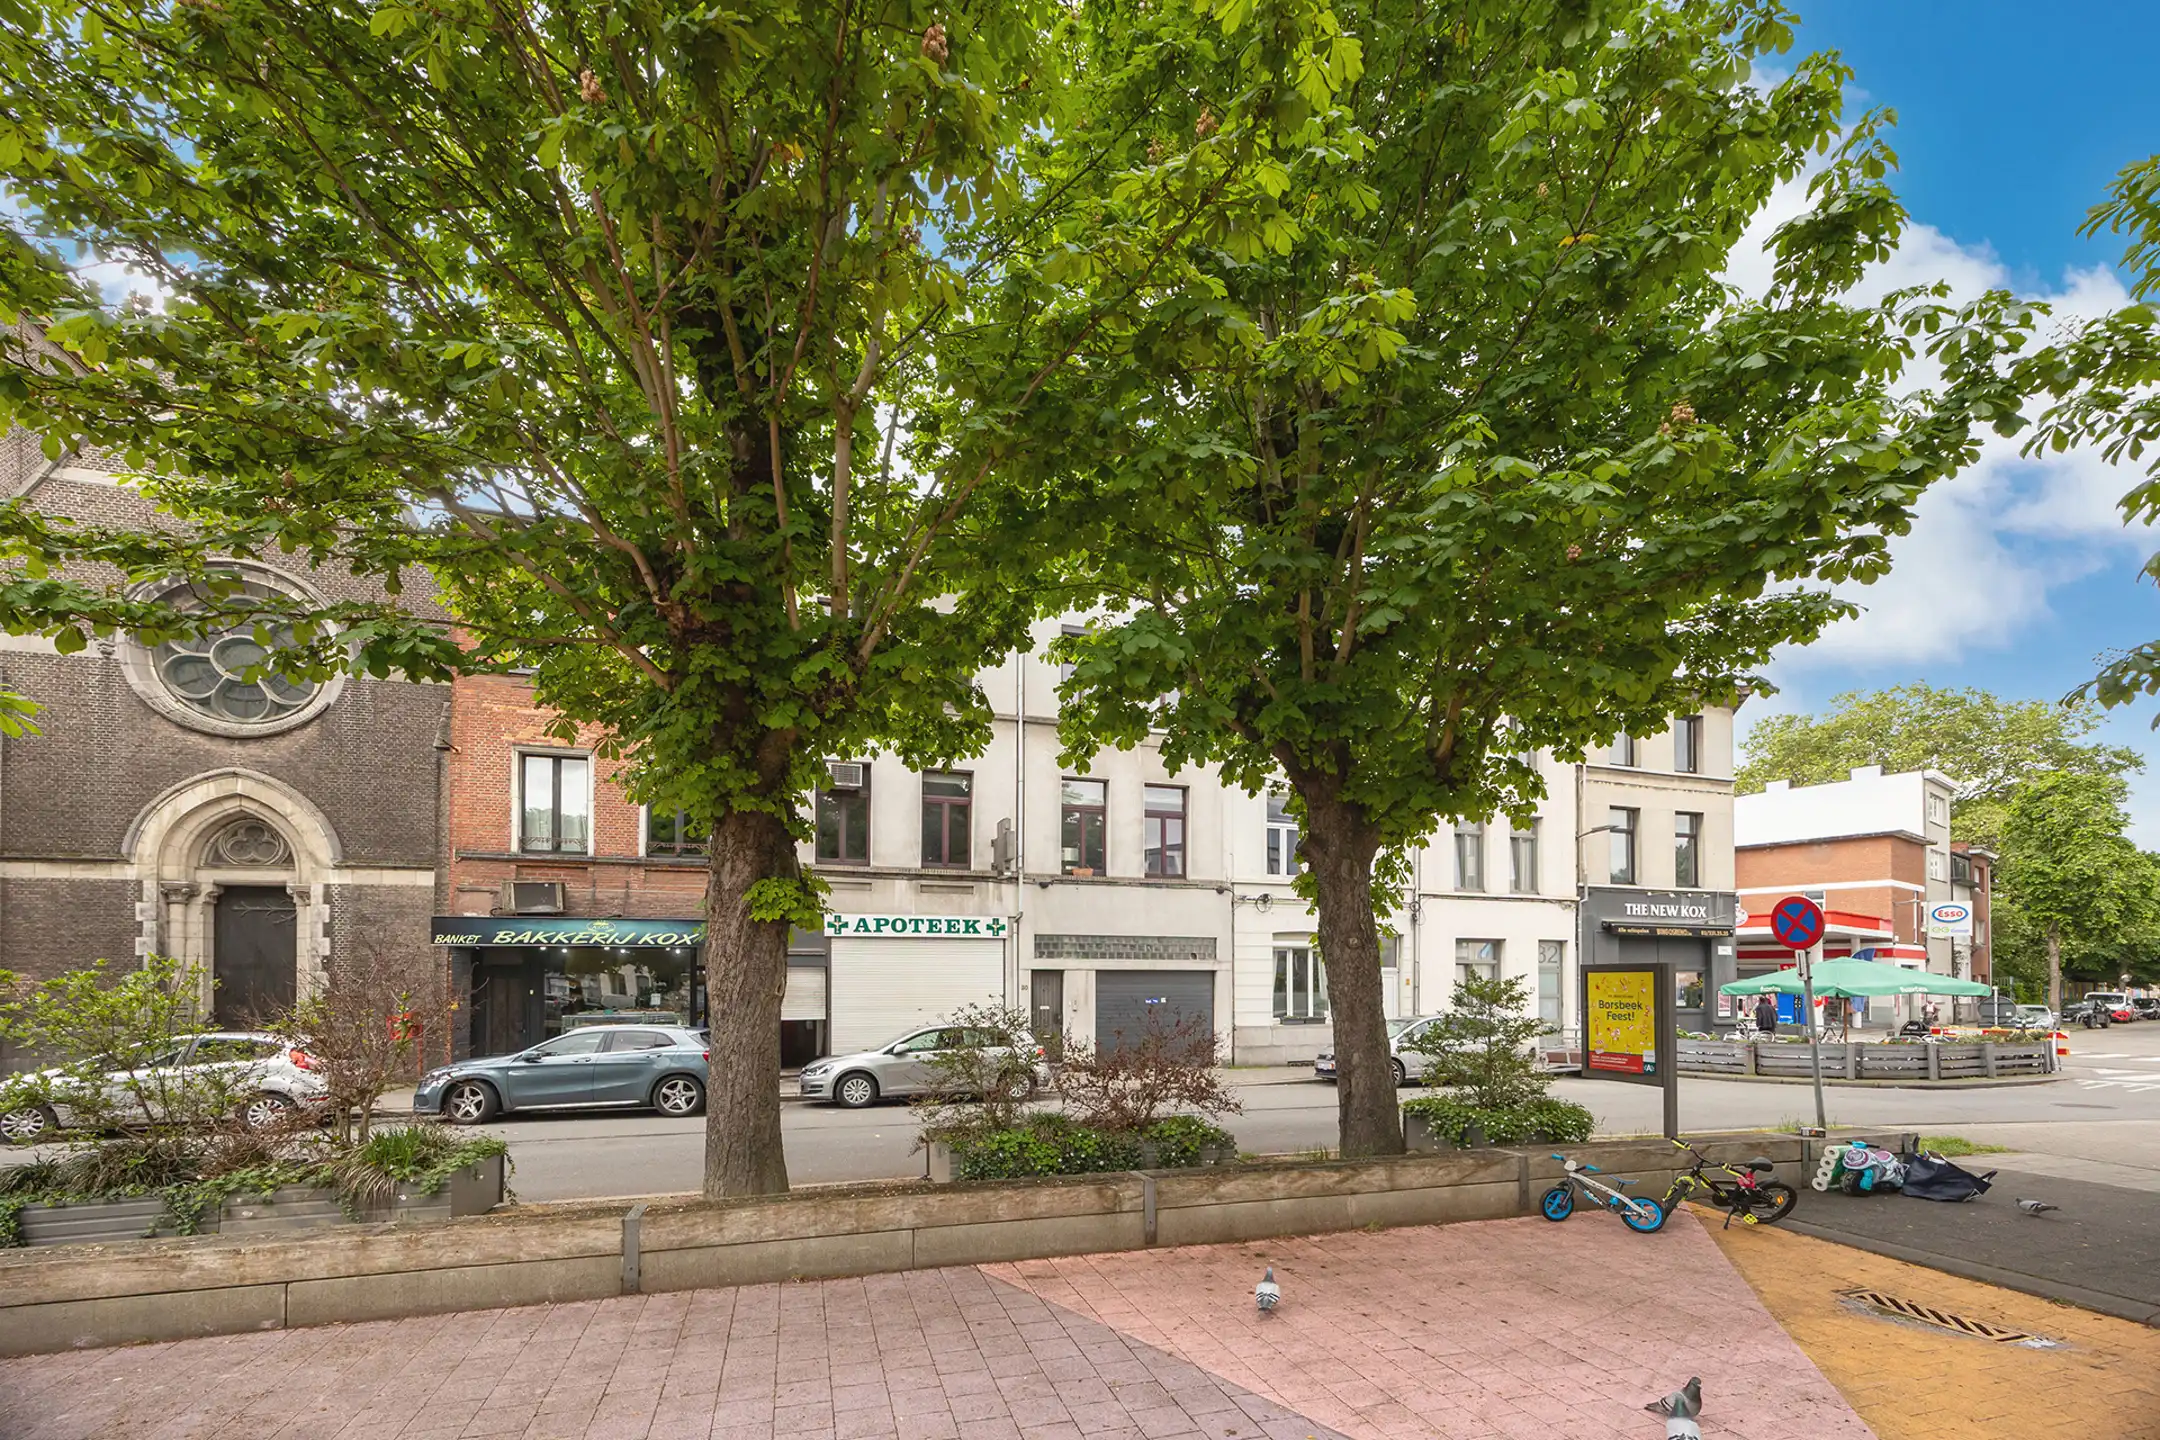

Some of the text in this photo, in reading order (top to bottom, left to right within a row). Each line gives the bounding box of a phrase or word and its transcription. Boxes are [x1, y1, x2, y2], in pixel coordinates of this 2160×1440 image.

[1624, 903, 1707, 918] THE NEW KOX
[1937, 909, 1963, 918] Esso
[853, 918, 981, 934] APOTEEK
[434, 934, 482, 944] BANKET
[492, 930, 700, 945] BAKKERIJ KOX
[1598, 999, 1643, 1011] Borsbeek
[1606, 1010, 1635, 1021] Feest!
